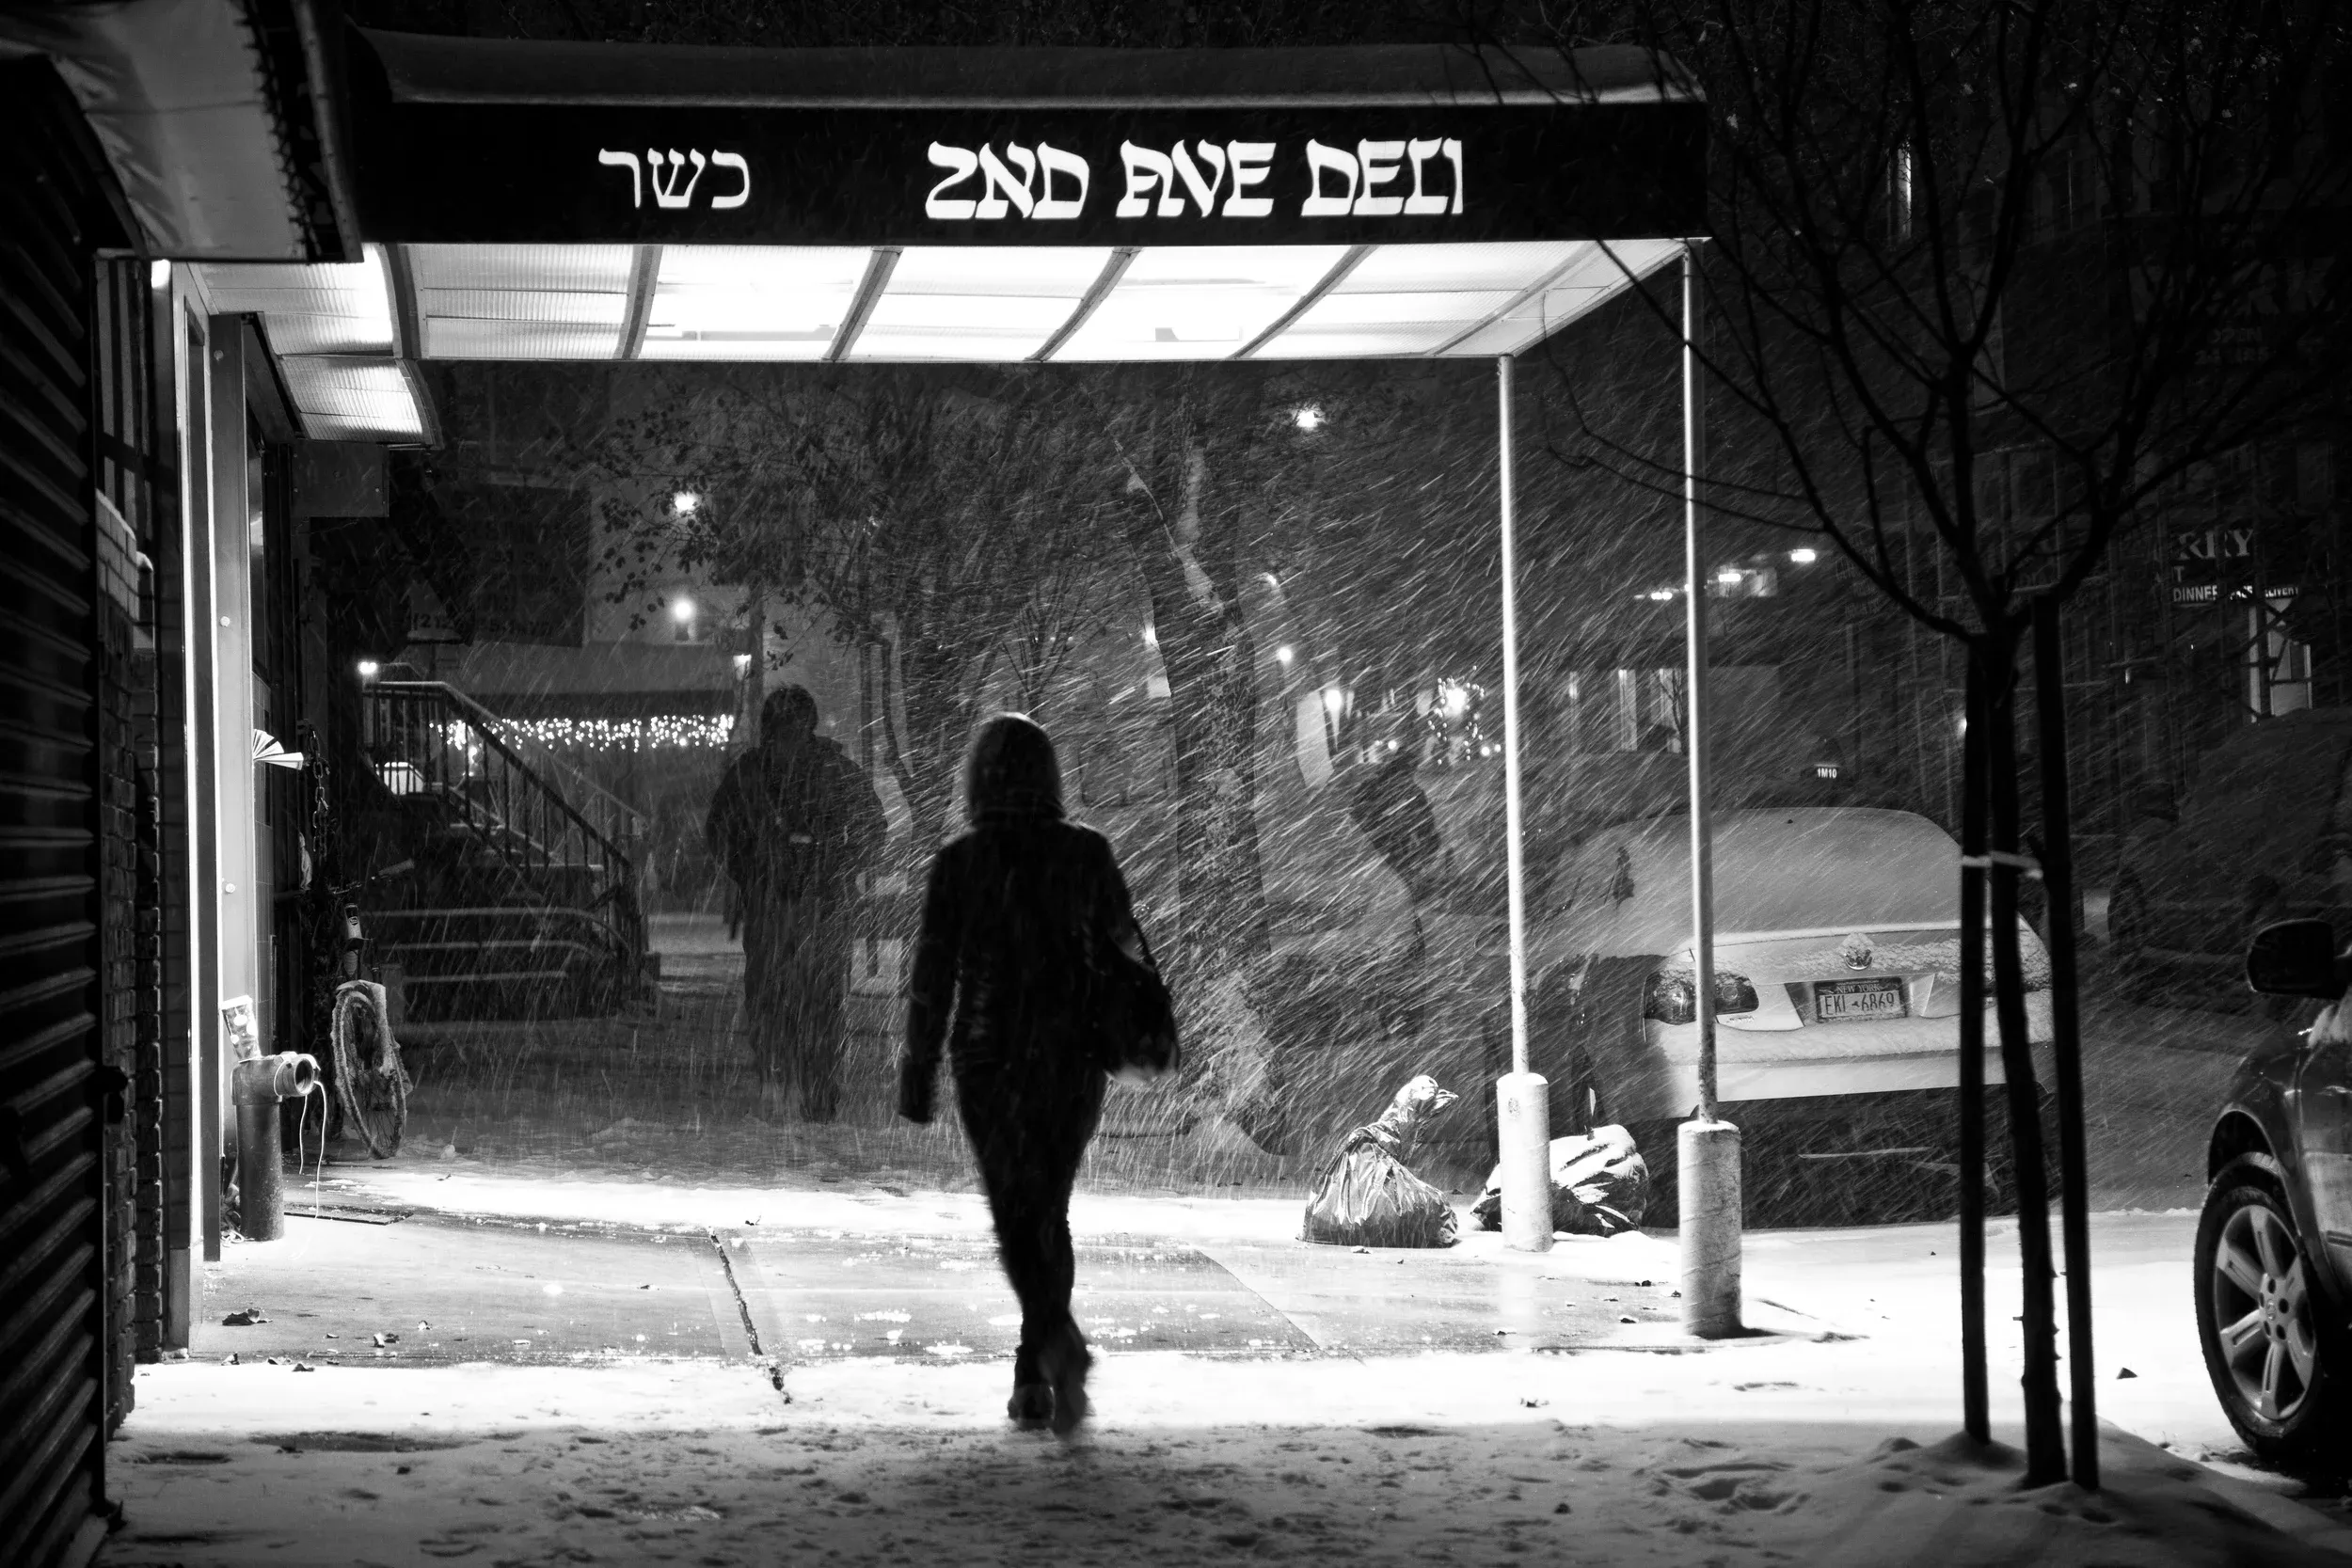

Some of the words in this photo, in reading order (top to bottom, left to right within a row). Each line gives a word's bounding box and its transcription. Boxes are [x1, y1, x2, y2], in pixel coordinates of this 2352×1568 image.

[598, 149, 750, 208] כשר
[926, 141, 1089, 219] 2ND
[1116, 139, 1276, 217] AVE
[1301, 137, 1463, 216] DELI
[1836, 985, 1856, 994] NEW
[1858, 983, 1882, 993] YORK
